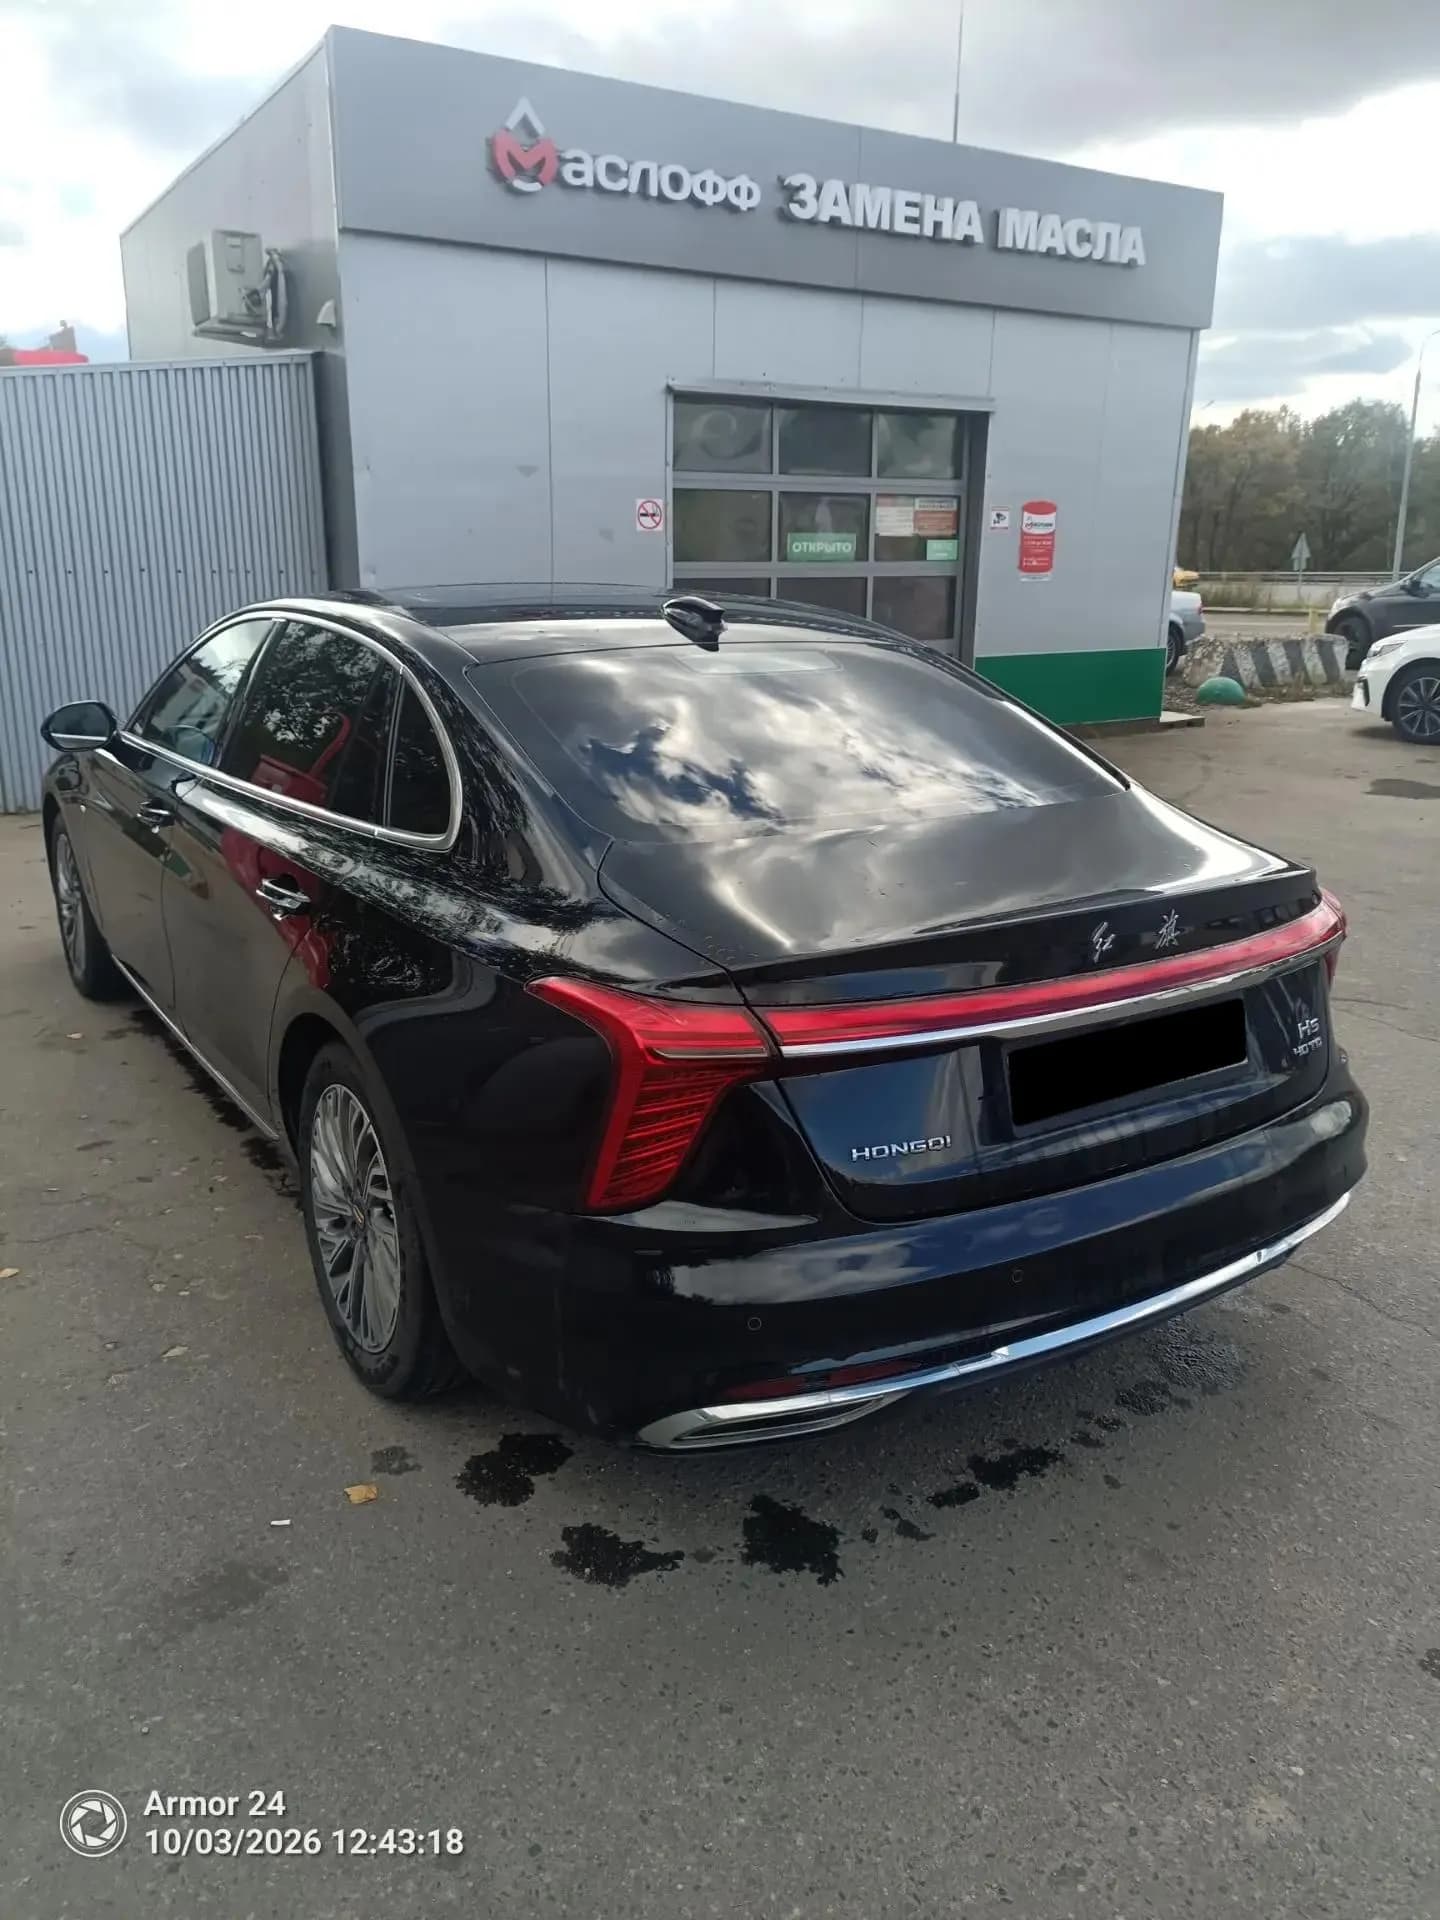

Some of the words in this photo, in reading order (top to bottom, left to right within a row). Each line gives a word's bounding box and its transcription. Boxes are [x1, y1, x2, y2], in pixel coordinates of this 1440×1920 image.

[783, 172, 984, 245] ЗАМЕНА
[997, 207, 1146, 266] МАСЛА
[792, 541, 852, 553] ОТКРЫТО
[851, 1135, 952, 1162] HONGQI
